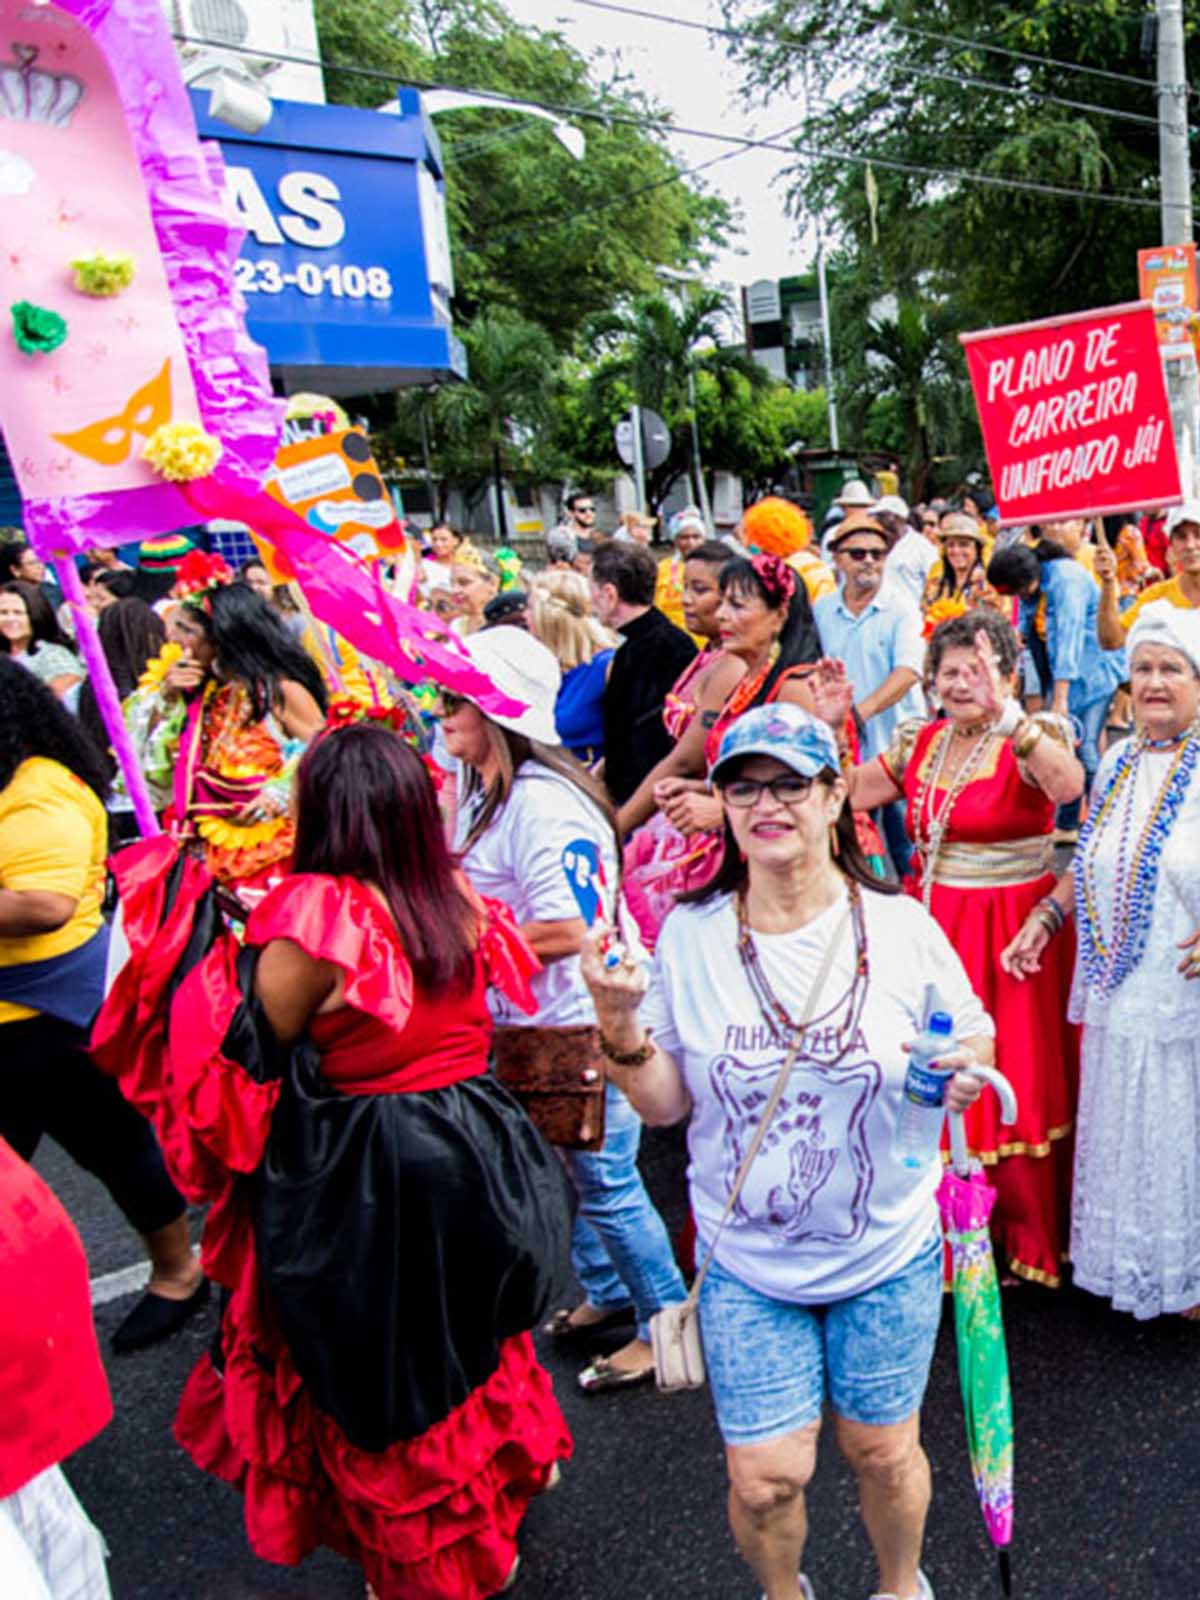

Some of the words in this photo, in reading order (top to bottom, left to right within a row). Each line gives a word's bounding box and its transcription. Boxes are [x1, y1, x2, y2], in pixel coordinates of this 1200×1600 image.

[987, 339, 1075, 403] PLANO
[1084, 323, 1121, 373] DE
[1008, 371, 1138, 448] CARREIRA
[1000, 434, 1119, 502] UNIFICADO
[1123, 416, 1164, 470] JÁ!
